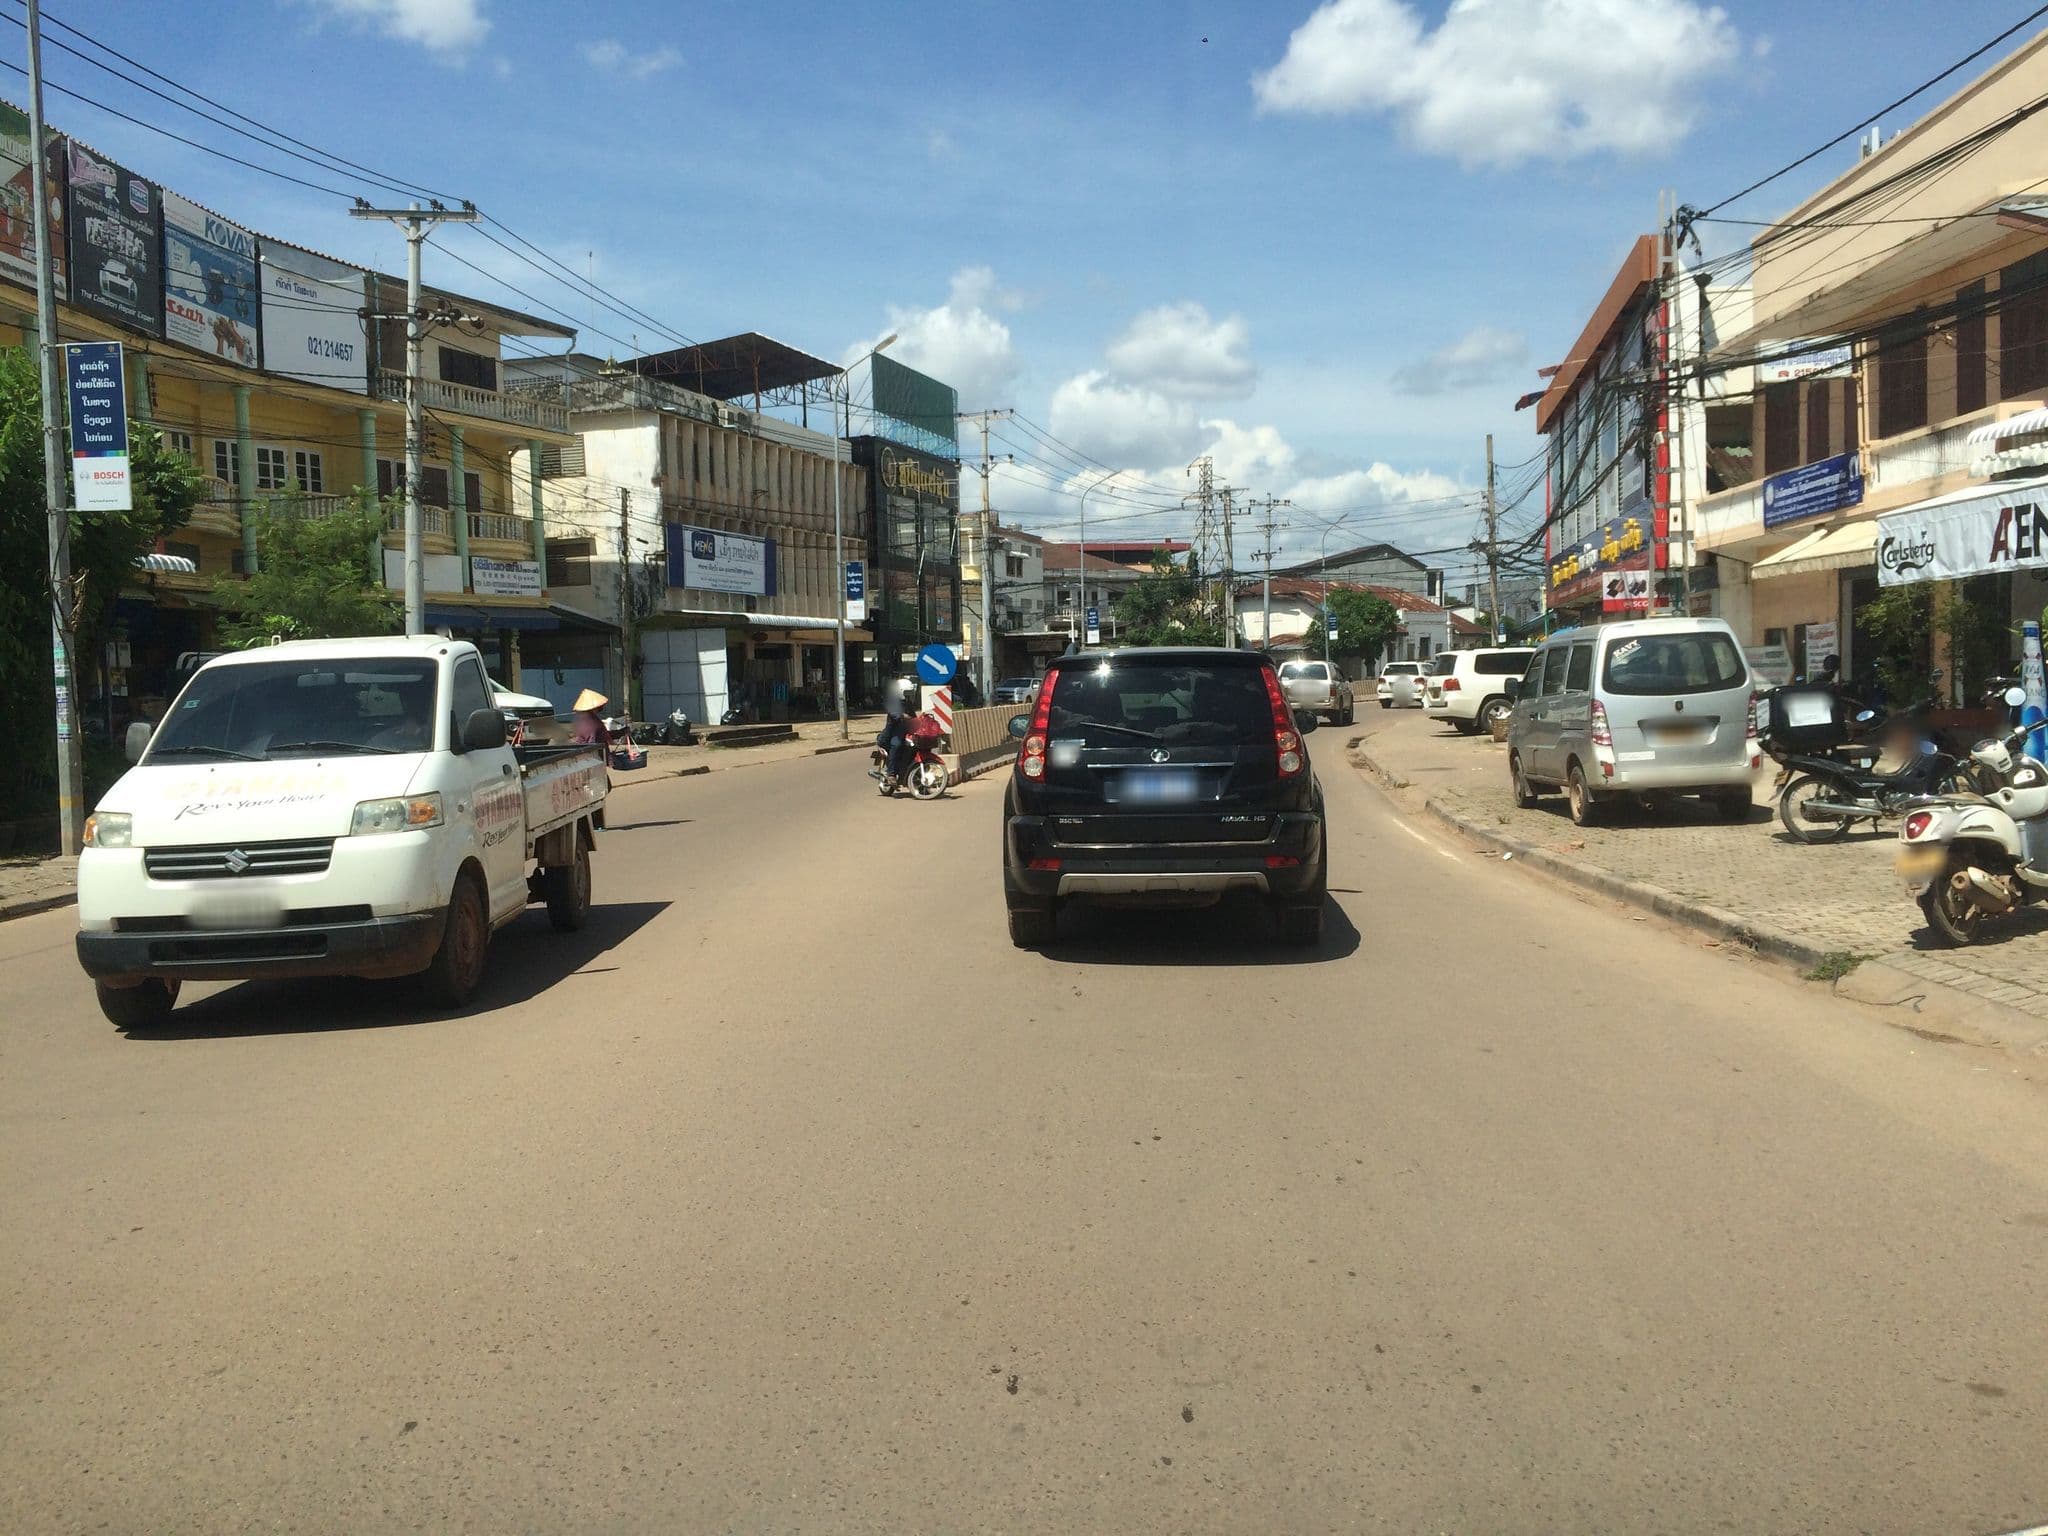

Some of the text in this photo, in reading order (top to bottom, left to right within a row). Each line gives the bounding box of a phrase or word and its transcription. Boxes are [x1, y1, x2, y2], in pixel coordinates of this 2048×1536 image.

[205, 216, 254, 257] KOVAX
[308, 336, 353, 362] 021 214657
[93, 471, 124, 480] BOSCH
[1881, 536, 1935, 570] Carlsberg
